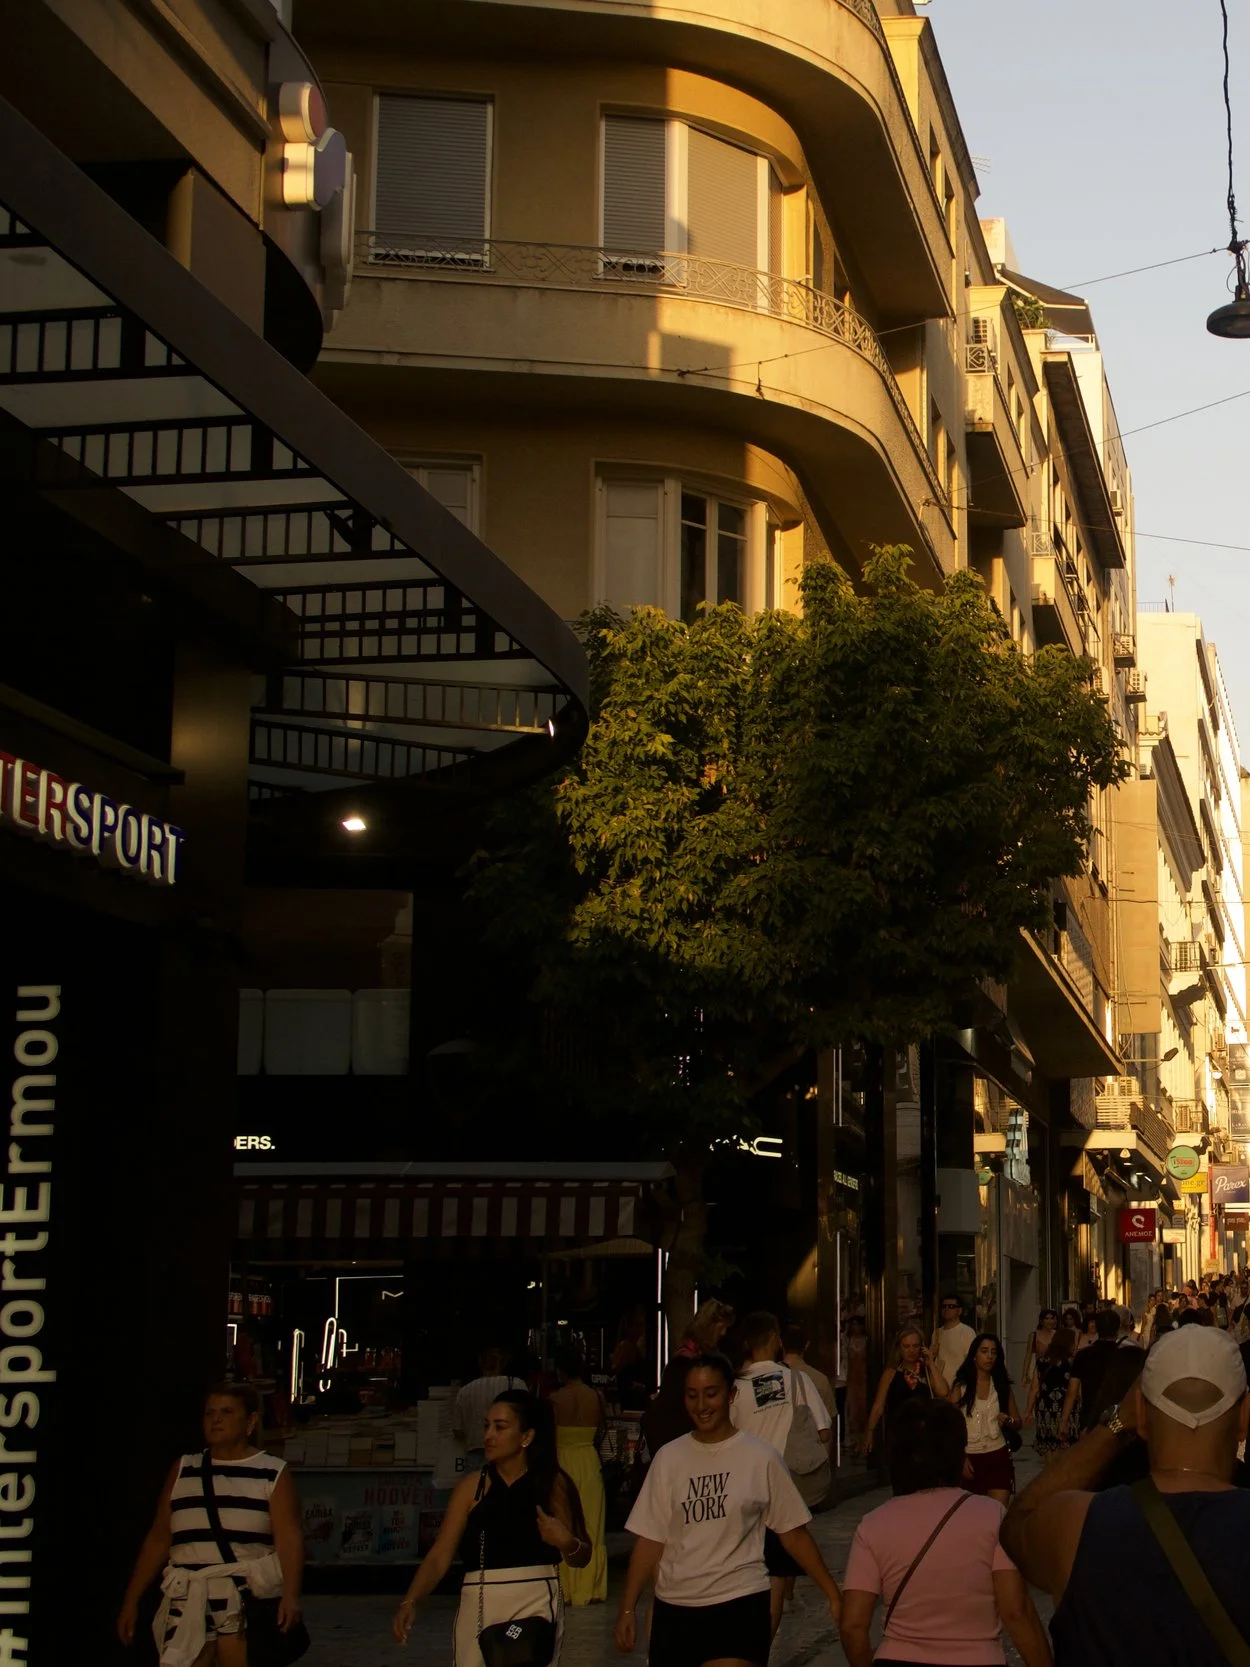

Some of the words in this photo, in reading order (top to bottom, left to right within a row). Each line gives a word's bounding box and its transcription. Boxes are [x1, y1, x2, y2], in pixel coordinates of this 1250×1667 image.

[234, 1136, 275, 1150] ERS.
[1215, 1175, 1247, 1193] Parex
[687, 1473, 730, 1500] NEW
[364, 1487, 434, 1506] HOOVER
[681, 1495, 728, 1524] YORK
